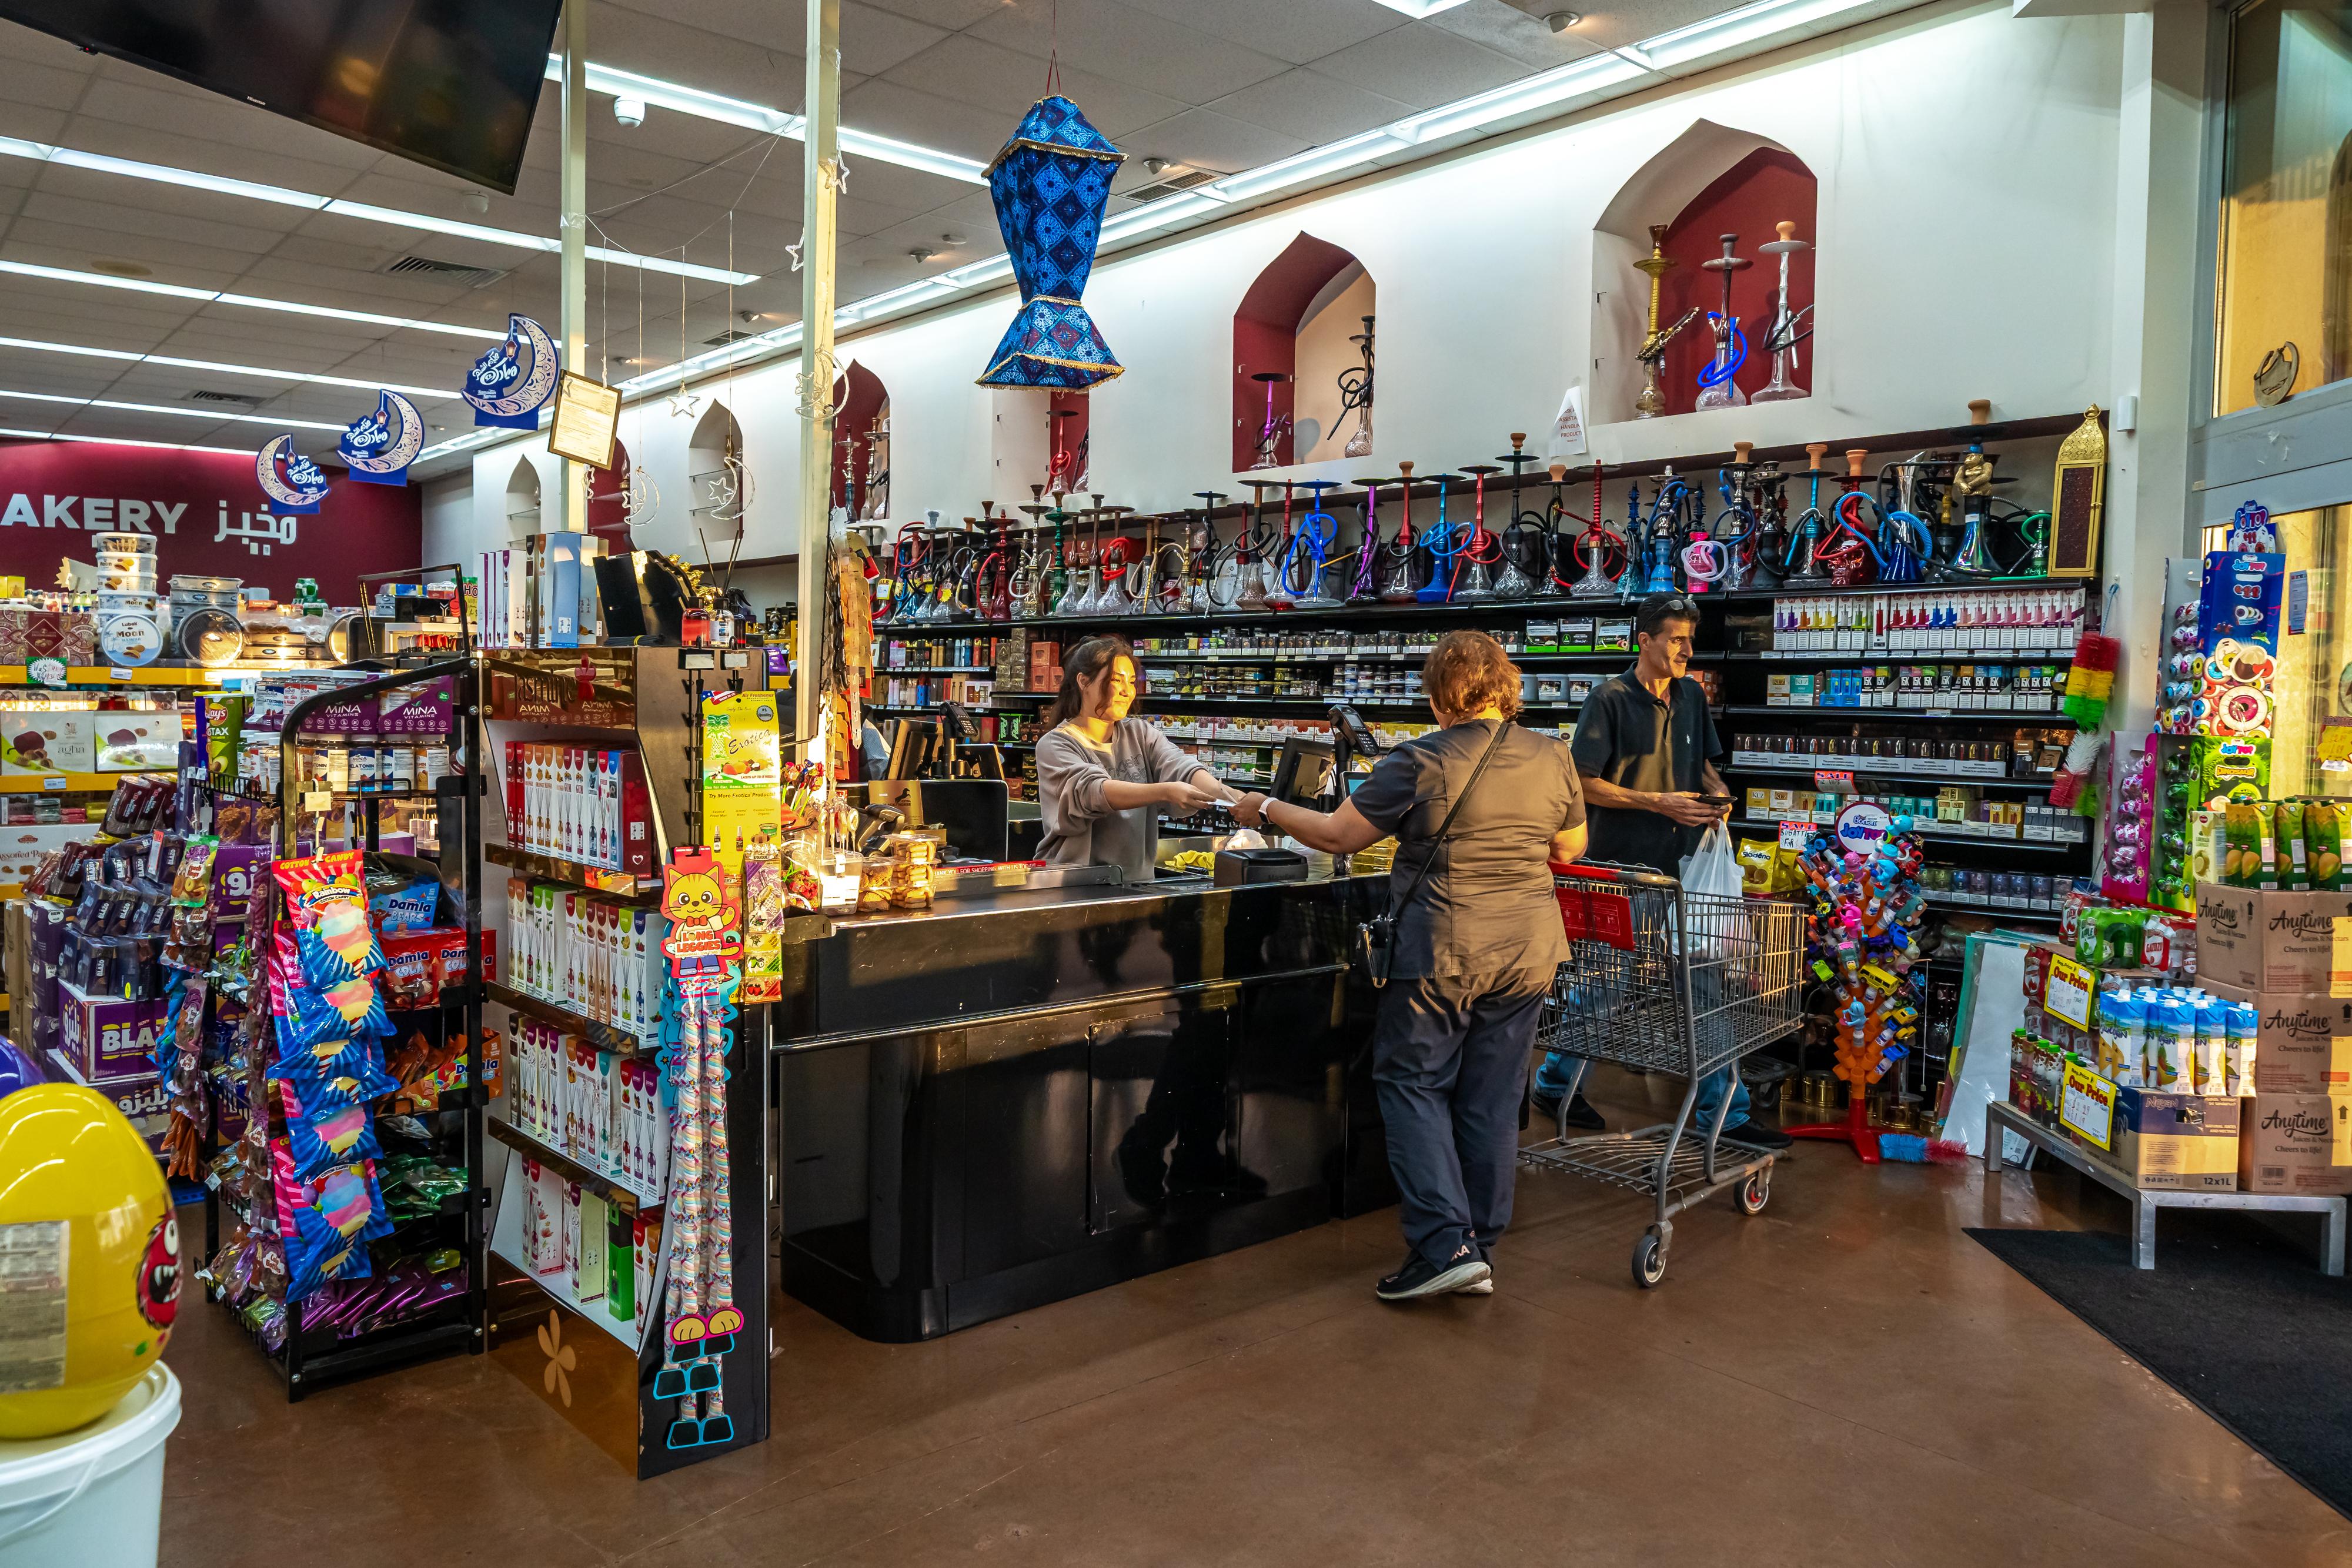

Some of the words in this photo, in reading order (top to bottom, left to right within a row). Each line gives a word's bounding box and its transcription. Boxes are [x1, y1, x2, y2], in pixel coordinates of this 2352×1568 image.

[1, 493, 188, 534] AKERY
[116, 629, 145, 637] Moon
[326, 705, 361, 714] MINA
[403, 706, 437, 715] MINA
[729, 729, 772, 754] Exotica
[280, 859, 310, 870] COTTON
[325, 852, 354, 863] CANDY
[312, 887, 351, 900] Rainbow
[388, 898, 432, 912] Damla
[2199, 897, 2238, 929] Anytime
[390, 911, 424, 924] BEARS
[2269, 910, 2335, 938] Anytime
[681, 930, 714, 942] LONG
[442, 949, 467, 959] Dam
[676, 941, 721, 952] LEGGIES
[388, 951, 429, 967] Damla
[445, 959, 467, 972] COL
[395, 961, 425, 978] COLA
[2053, 966, 2068, 982] Our
[2069, 972, 2089, 992] Price
[2264, 1009, 2331, 1038] Anytime
[102, 1027, 159, 1052] BLA
[2069, 1075, 2084, 1094] Our
[2086, 1083, 2108, 1106] Price
[2261, 1109, 2328, 1138] Anytime
